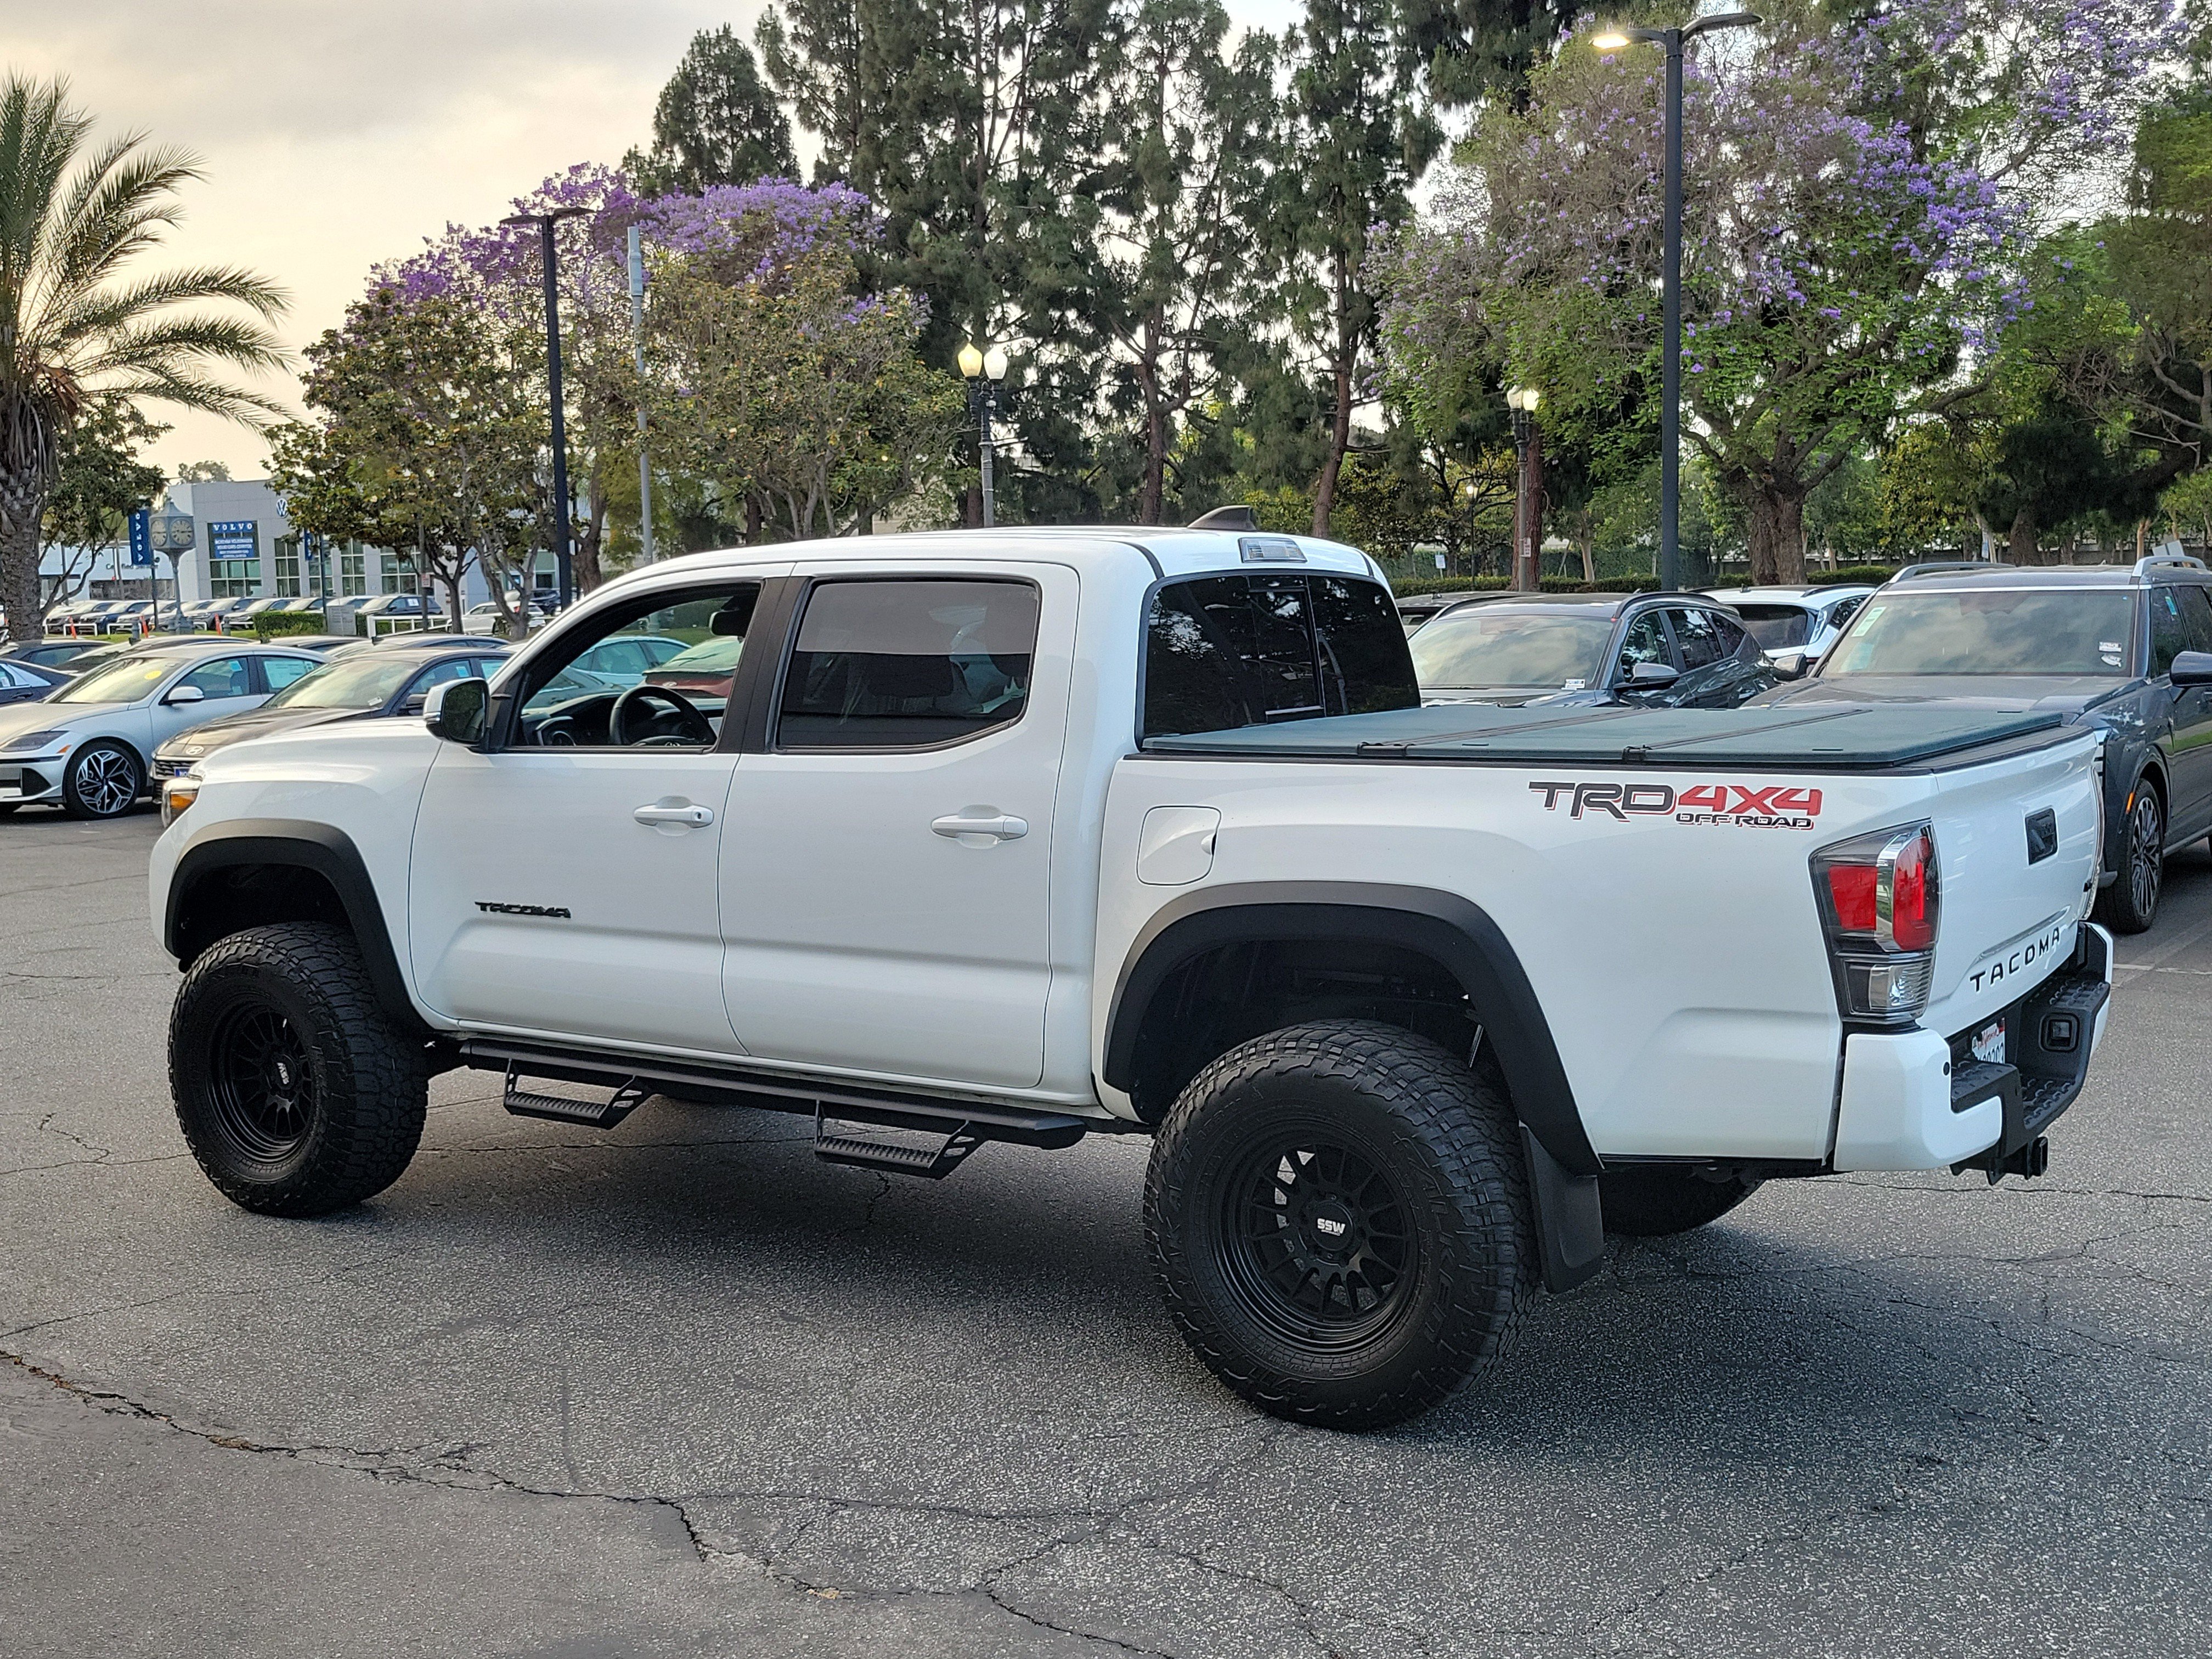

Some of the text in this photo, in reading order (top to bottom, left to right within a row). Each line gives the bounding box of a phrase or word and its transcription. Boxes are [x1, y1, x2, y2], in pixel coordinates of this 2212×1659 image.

[213, 523, 252, 531] VOLVO
[1675, 813, 1814, 830] OFF ROAD
[475, 901, 571, 918] TACOMA
[1970, 927, 2061, 992] TACOMA
[1317, 1218, 1346, 1234] SSW
